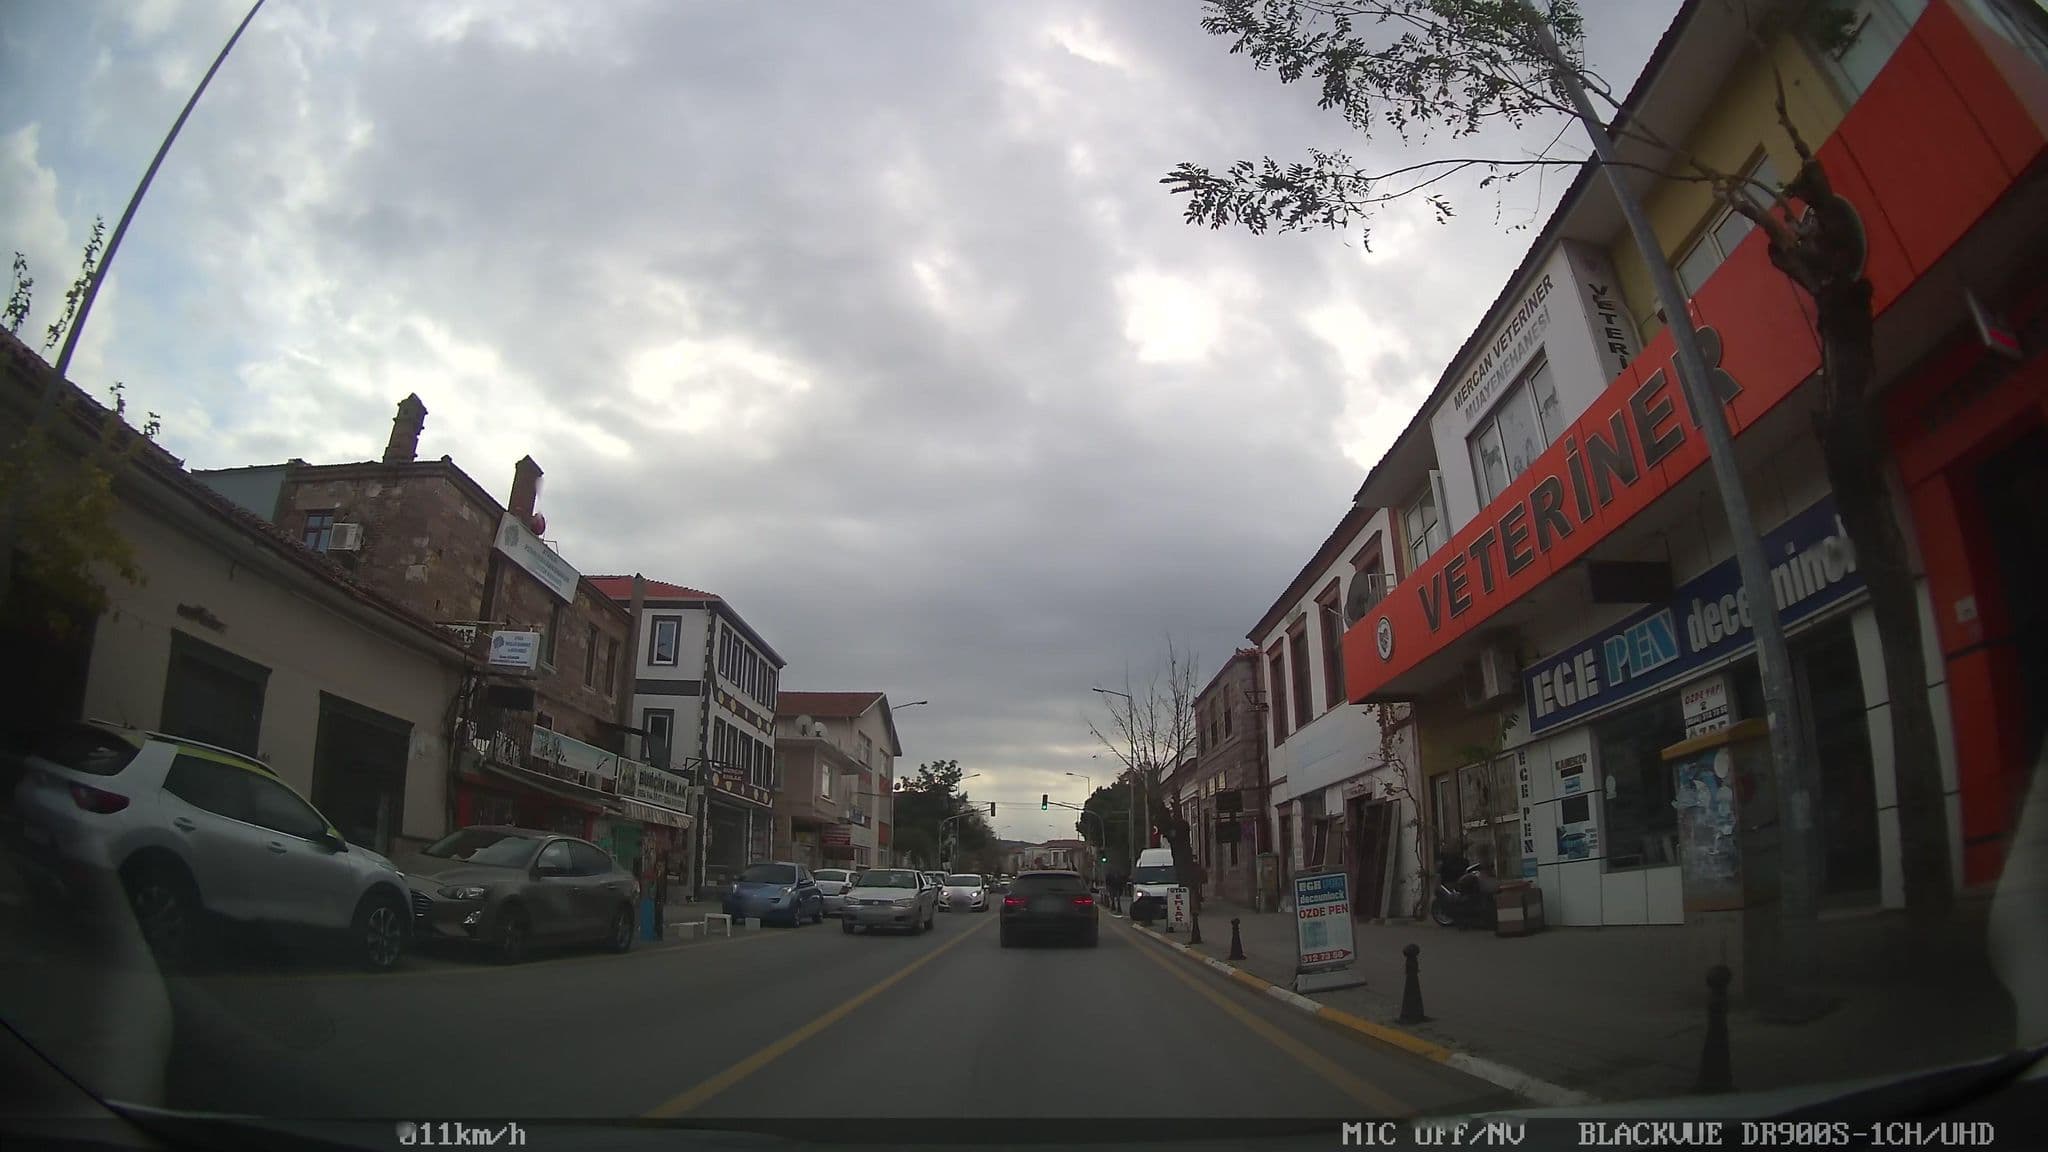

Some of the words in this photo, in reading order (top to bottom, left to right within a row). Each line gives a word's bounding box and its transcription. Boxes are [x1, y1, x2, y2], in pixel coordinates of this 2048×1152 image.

[1454, 353, 1492, 411] MERCAN
[1493, 274, 1554, 358] VETERİNER
[1464, 304, 1551, 422] MUAYENEHANESİ
[1588, 283, 1630, 376] VETERİ
[1416, 324, 1744, 634] VETERİNER
[1531, 648, 1600, 721] EGE
[1603, 607, 1680, 687] PEN
[1523, 807, 1534, 853] PEN
[1328, 903, 1349, 915] PEN
